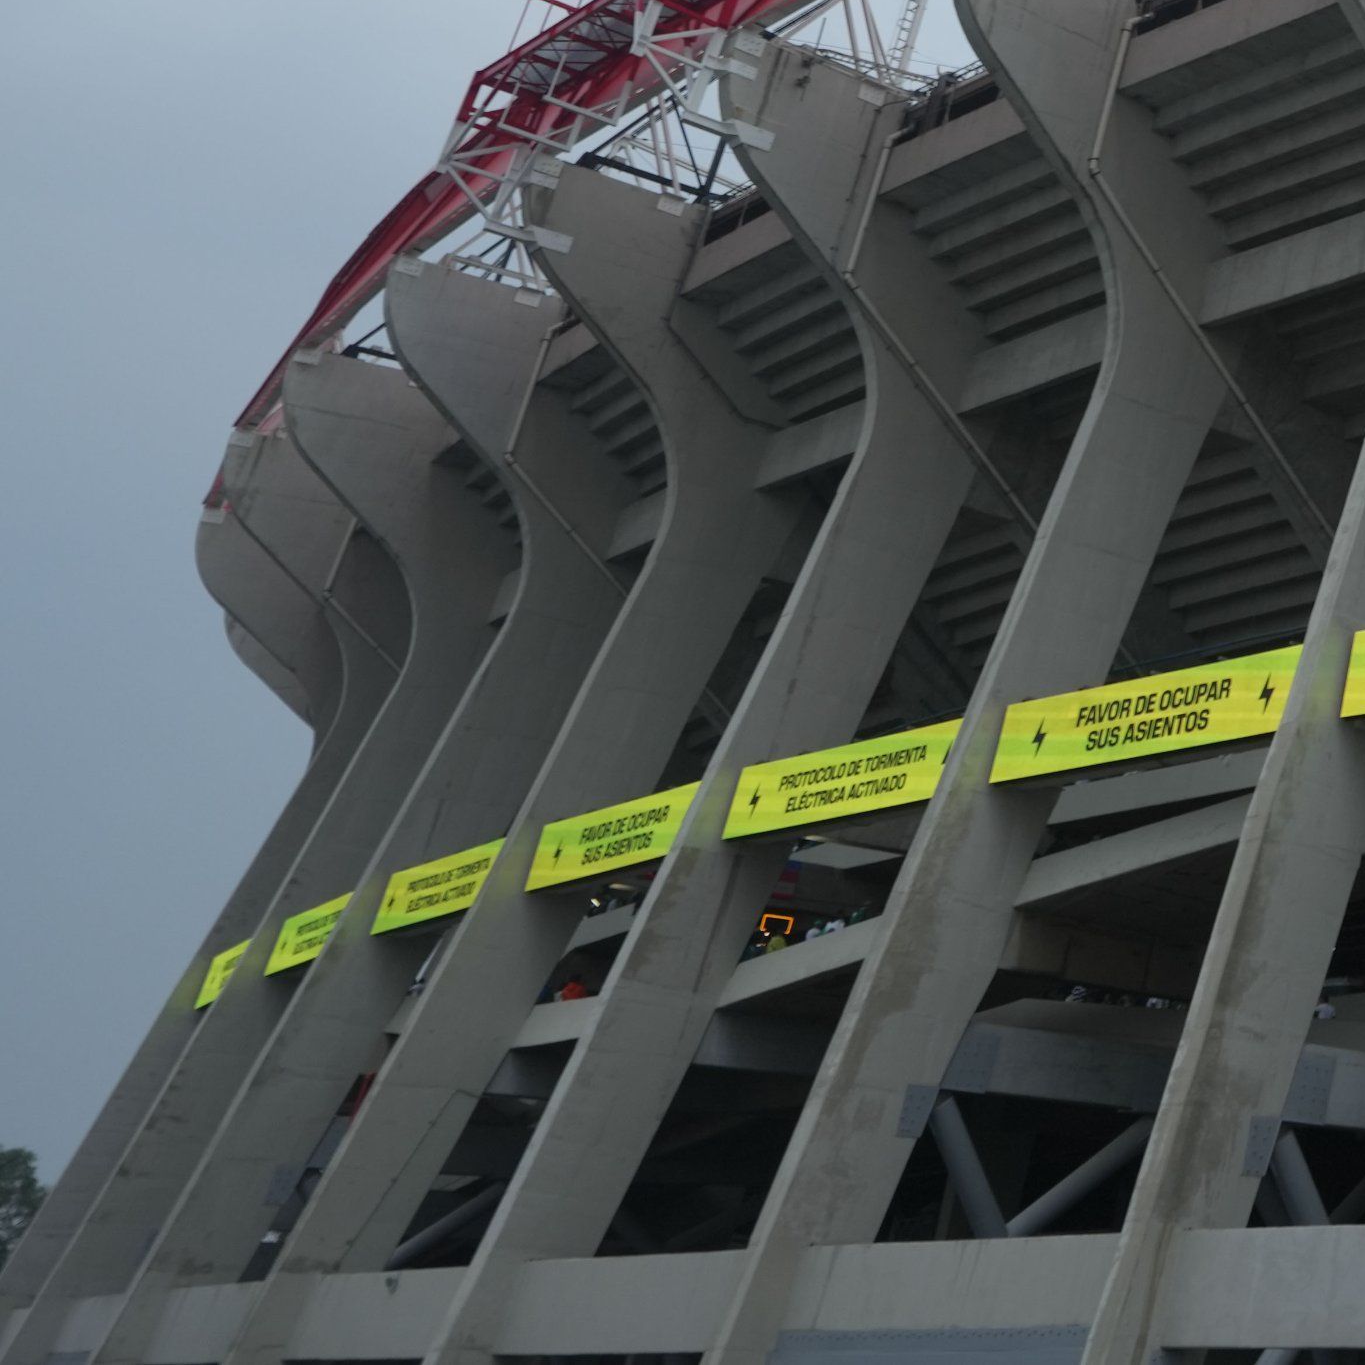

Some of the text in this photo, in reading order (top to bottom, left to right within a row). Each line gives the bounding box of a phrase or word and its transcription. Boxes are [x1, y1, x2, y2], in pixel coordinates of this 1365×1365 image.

[1076, 678, 1232, 728] FAVOR DE OCUPAR
[1085, 708, 1210, 752] SUS ASIENTOS
[778, 745, 928, 792] PROTOCOLO DE TORMENTA
[785, 773, 907, 814] ELÉCTRICA ACTIVADO
[579, 805, 671, 845] FAVOR DE OCUPAR
[581, 831, 654, 865] SUS ASIENTOS
